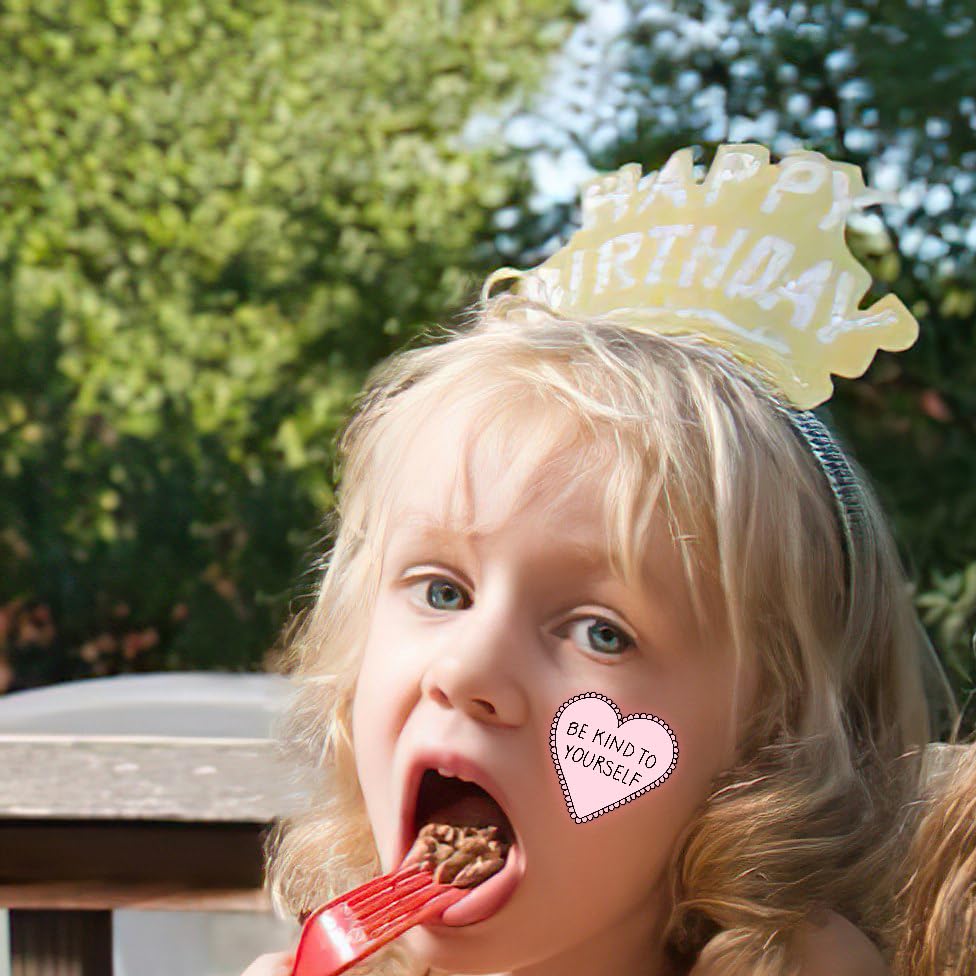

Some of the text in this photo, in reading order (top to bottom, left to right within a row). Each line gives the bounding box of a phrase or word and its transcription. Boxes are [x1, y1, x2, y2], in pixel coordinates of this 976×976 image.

[565, 745, 642, 786] YOURSELF
[567, 722, 657, 768] BE KIND TO
